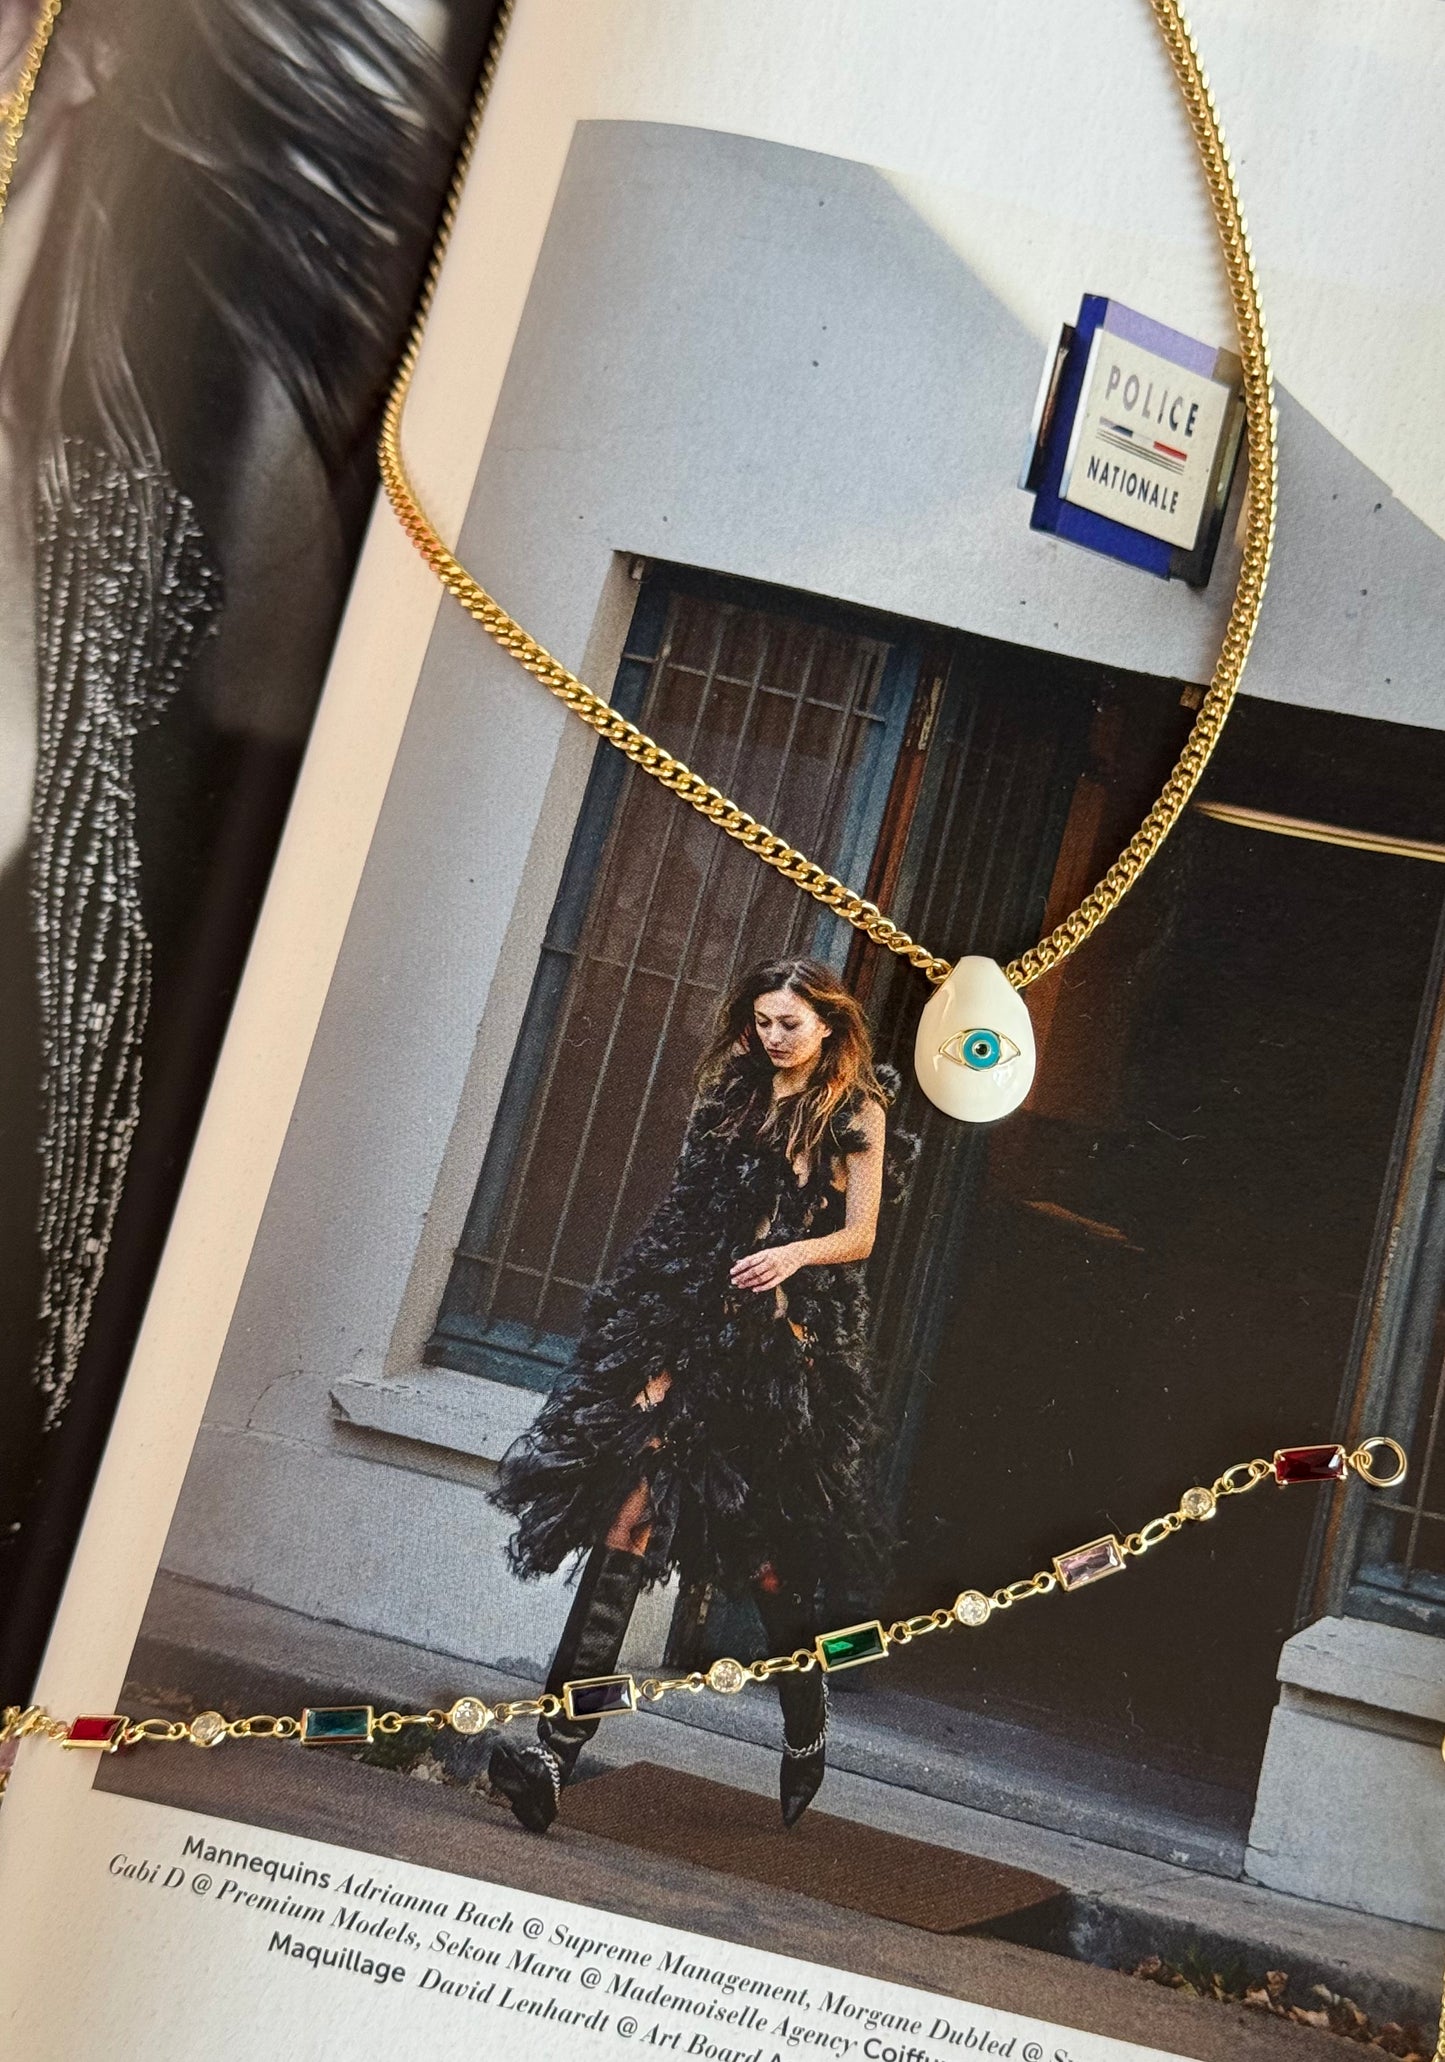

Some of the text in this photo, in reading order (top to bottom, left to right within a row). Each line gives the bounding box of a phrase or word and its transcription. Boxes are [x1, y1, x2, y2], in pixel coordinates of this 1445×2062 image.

[1105, 364, 1199, 437] POLICE
[1087, 455, 1179, 514] NATIONALE
[109, 1854, 945, 2062] Gabi D @ Premium Models, Sekou Mara @ Mademoiselle Agency Coiff
[182, 1835, 1043, 2062] Mannequins Adrianna Bach @ Supreme Management, Morgane Dubled @
[268, 1931, 763, 2062] Maquillage David Lenhardt @ Art Board
